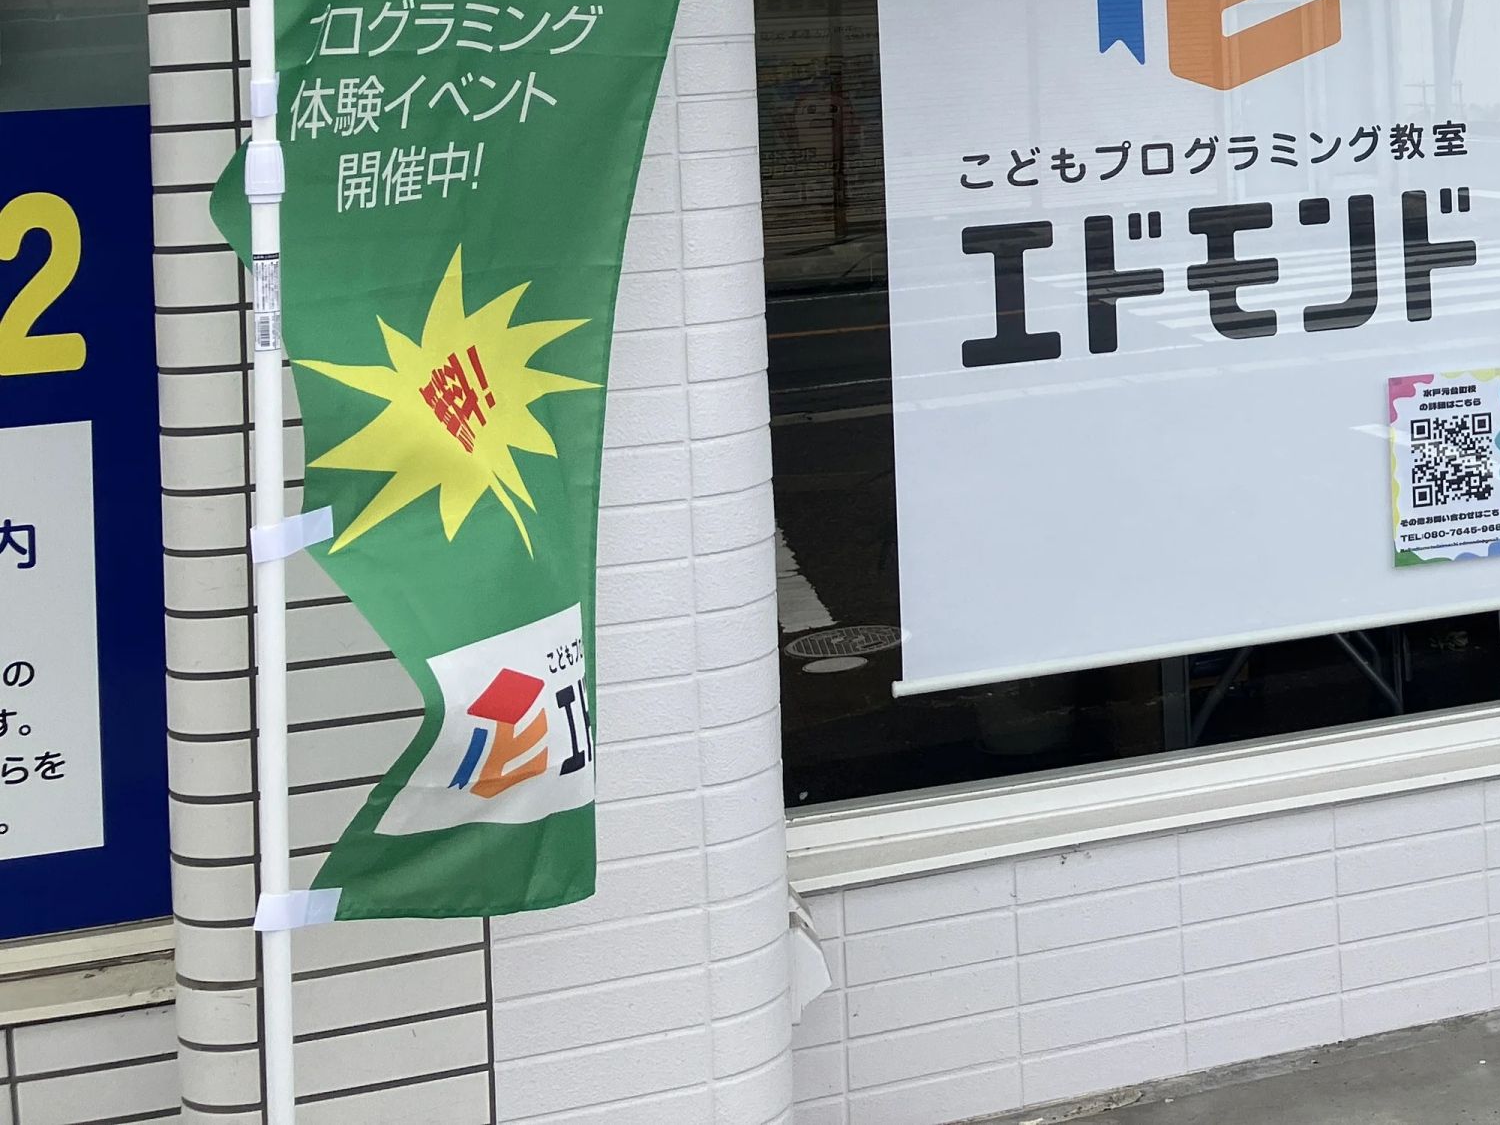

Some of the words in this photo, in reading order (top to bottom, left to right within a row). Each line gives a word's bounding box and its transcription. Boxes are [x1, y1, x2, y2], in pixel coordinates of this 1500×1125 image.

[290, 71, 557, 141] 体験イベント
[337, 142, 483, 213] 開催中!
[960, 121, 1468, 189] こどもプログラミング教室
[961, 187, 1477, 368] エドモンド
[547, 639, 584, 674] こどもプ
